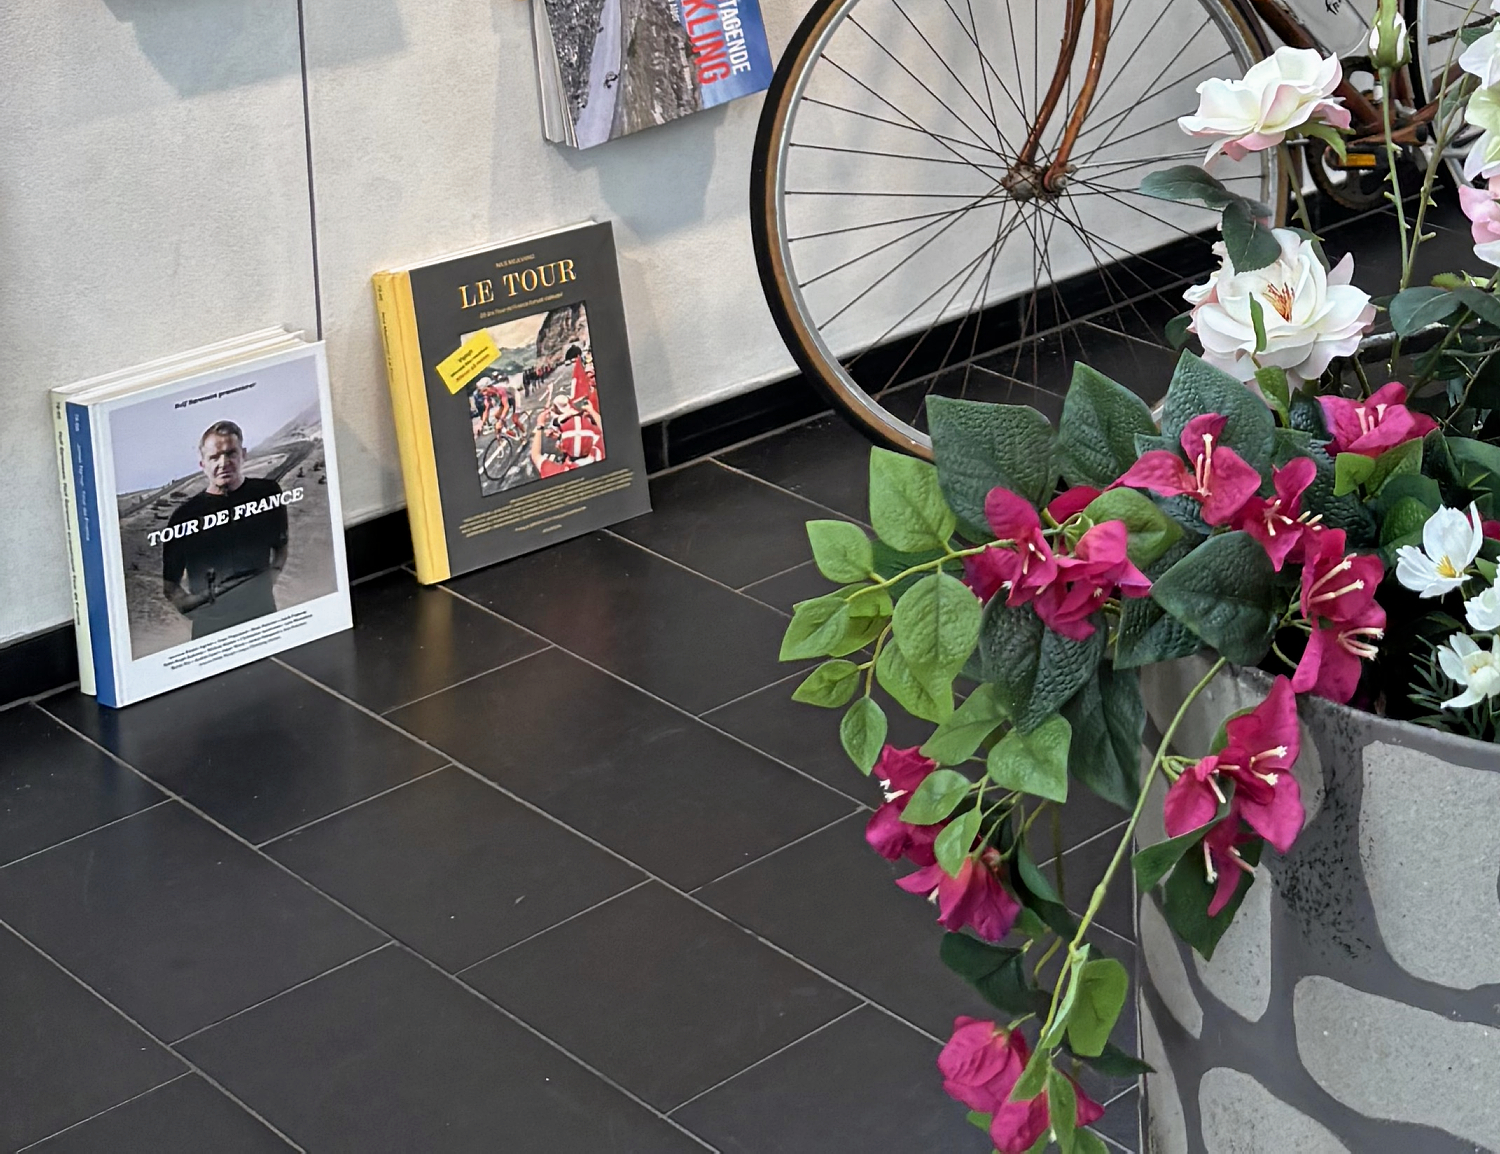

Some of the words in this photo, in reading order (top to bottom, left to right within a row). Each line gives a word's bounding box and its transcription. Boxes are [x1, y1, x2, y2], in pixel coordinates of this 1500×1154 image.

[458, 279, 494, 310] LE
[502, 258, 577, 298] TOUR
[147, 518, 199, 548] TOUR
[203, 509, 229, 531] DE
[233, 487, 304, 522] FRANCE
